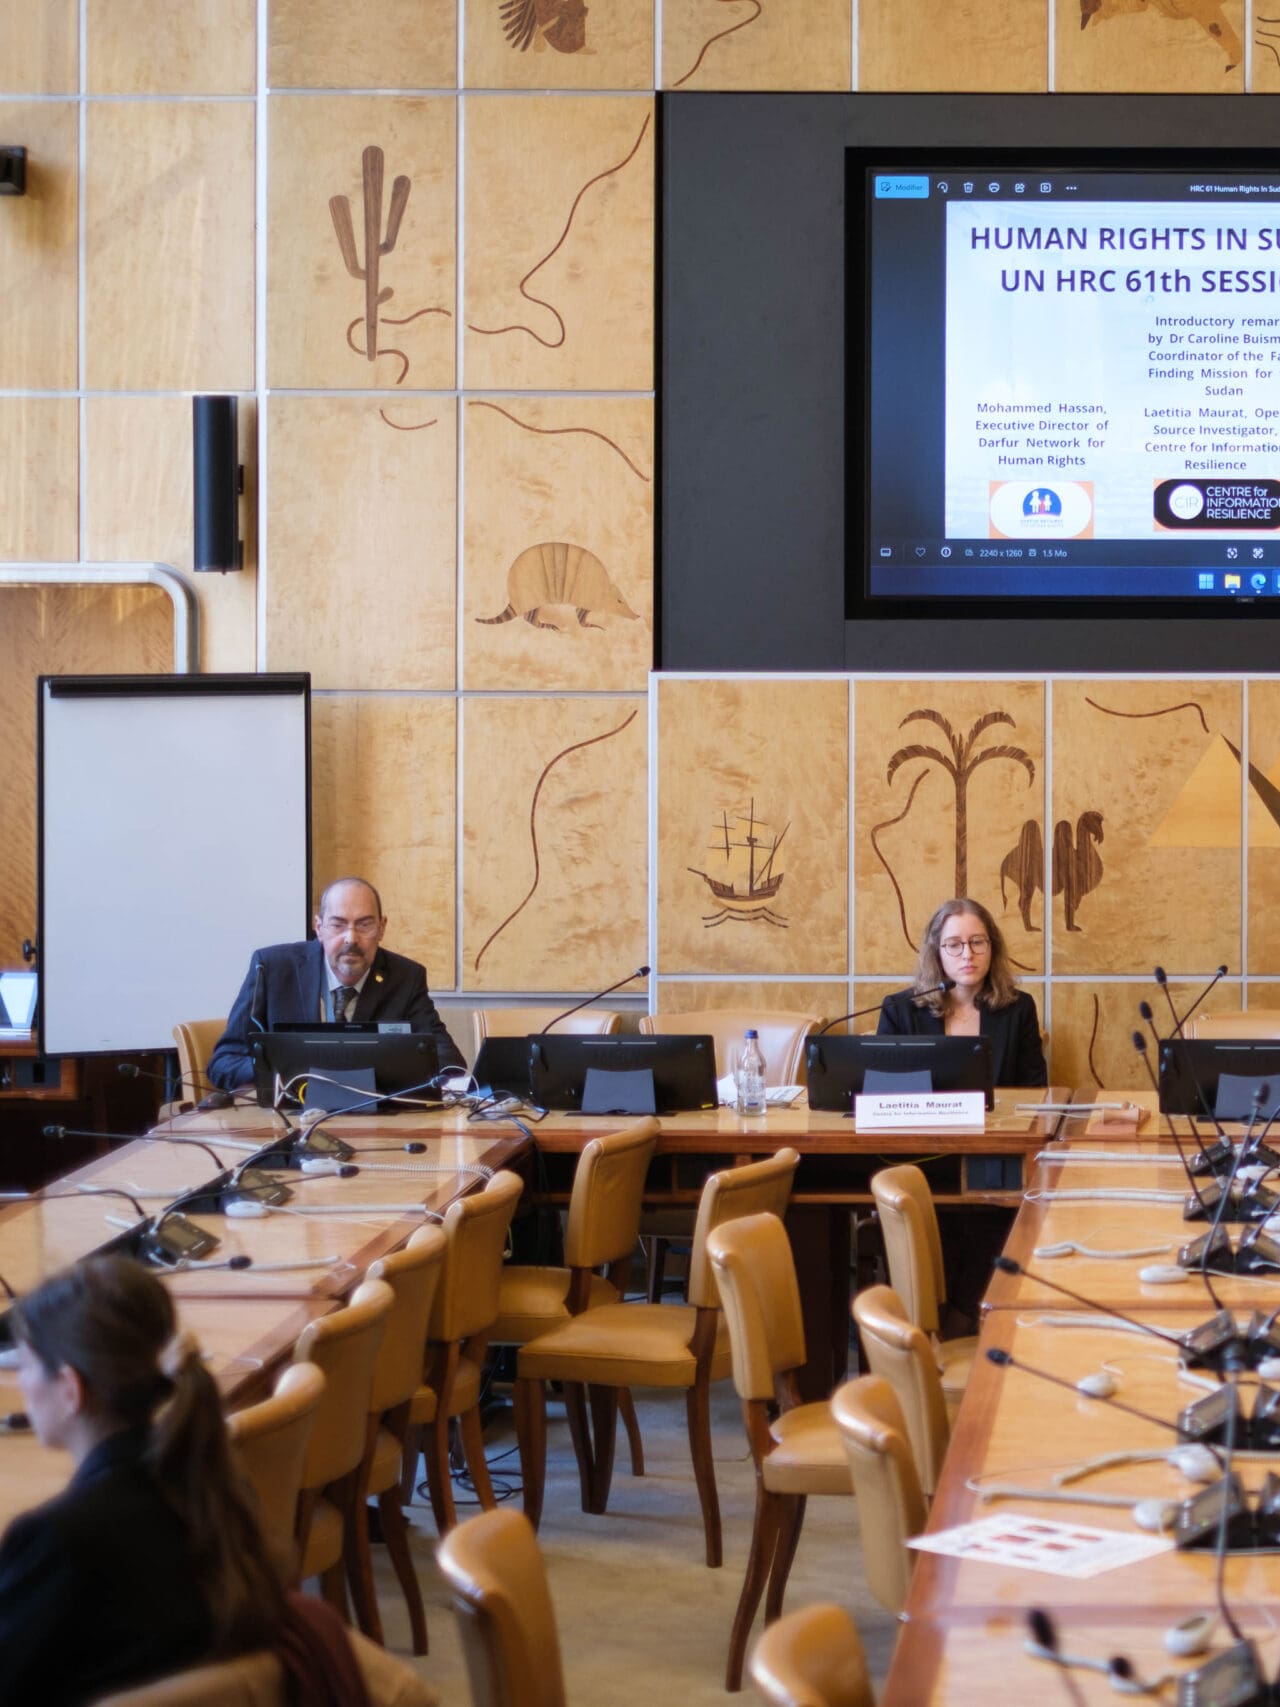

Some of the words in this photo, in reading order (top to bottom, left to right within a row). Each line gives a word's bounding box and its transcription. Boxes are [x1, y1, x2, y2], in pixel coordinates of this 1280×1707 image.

[1190, 185, 1204, 193] HRC
[1205, 185, 1213, 193] 61
[1214, 185, 1238, 193] Human
[1239, 185, 1260, 194] Rights
[971, 227, 1088, 250] HUMAN
[1099, 227, 1206, 250] RIGHTS
[1216, 227, 1247, 251] IN
[1001, 269, 1045, 292] UN
[1056, 269, 1117, 292] HRC
[1125, 269, 1191, 293] 61th
[1155, 317, 1235, 328] Introductory
[1148, 333, 1163, 346] by
[1169, 333, 1183, 344] Dr
[1187, 333, 1240, 344] Caroline
[1148, 350, 1224, 361] Coordinator
[1226, 350, 1241, 361] of
[1243, 350, 1264, 362] the
[1148, 367, 1195, 380] Finding
[1200, 368, 1248, 379] Mission
[1255, 368, 1273, 379] for
[1204, 385, 1244, 396] Sudan
[977, 402, 1052, 413] Mohammed
[1058, 403, 1107, 416] Hassan,
[1144, 408, 1191, 418] Laetitia
[1198, 408, 1248, 420] Maurat,
[975, 420, 1036, 431] Executive
[1038, 420, 1090, 431] Director
[1096, 419, 1109, 431] of
[1153, 424, 1196, 436] Source
[1199, 426, 1278, 439] Investigator,
[978, 437, 1020, 448] Darfur
[1026, 438, 1081, 448] Network
[1087, 437, 1105, 448] for
[1144, 442, 1187, 453] Centre
[1190, 442, 1208, 453] for
[998, 455, 1044, 465] Human
[1047, 455, 1086, 469] Rights
[1184, 459, 1247, 470] Resilience
[1206, 486, 1251, 497] CENTRE
[1253, 486, 1268, 497] for
[1174, 497, 1200, 509] CIR
[1207, 509, 1271, 519] RESILIENCE
[980, 549, 998, 557] 2240
[1005, 549, 1023, 557] 1260
[1043, 549, 1053, 557] 1.5
[1055, 549, 1068, 557] Mo
[879, 1101, 920, 1109] Laetitia
[926, 1101, 963, 1109] Maurat
